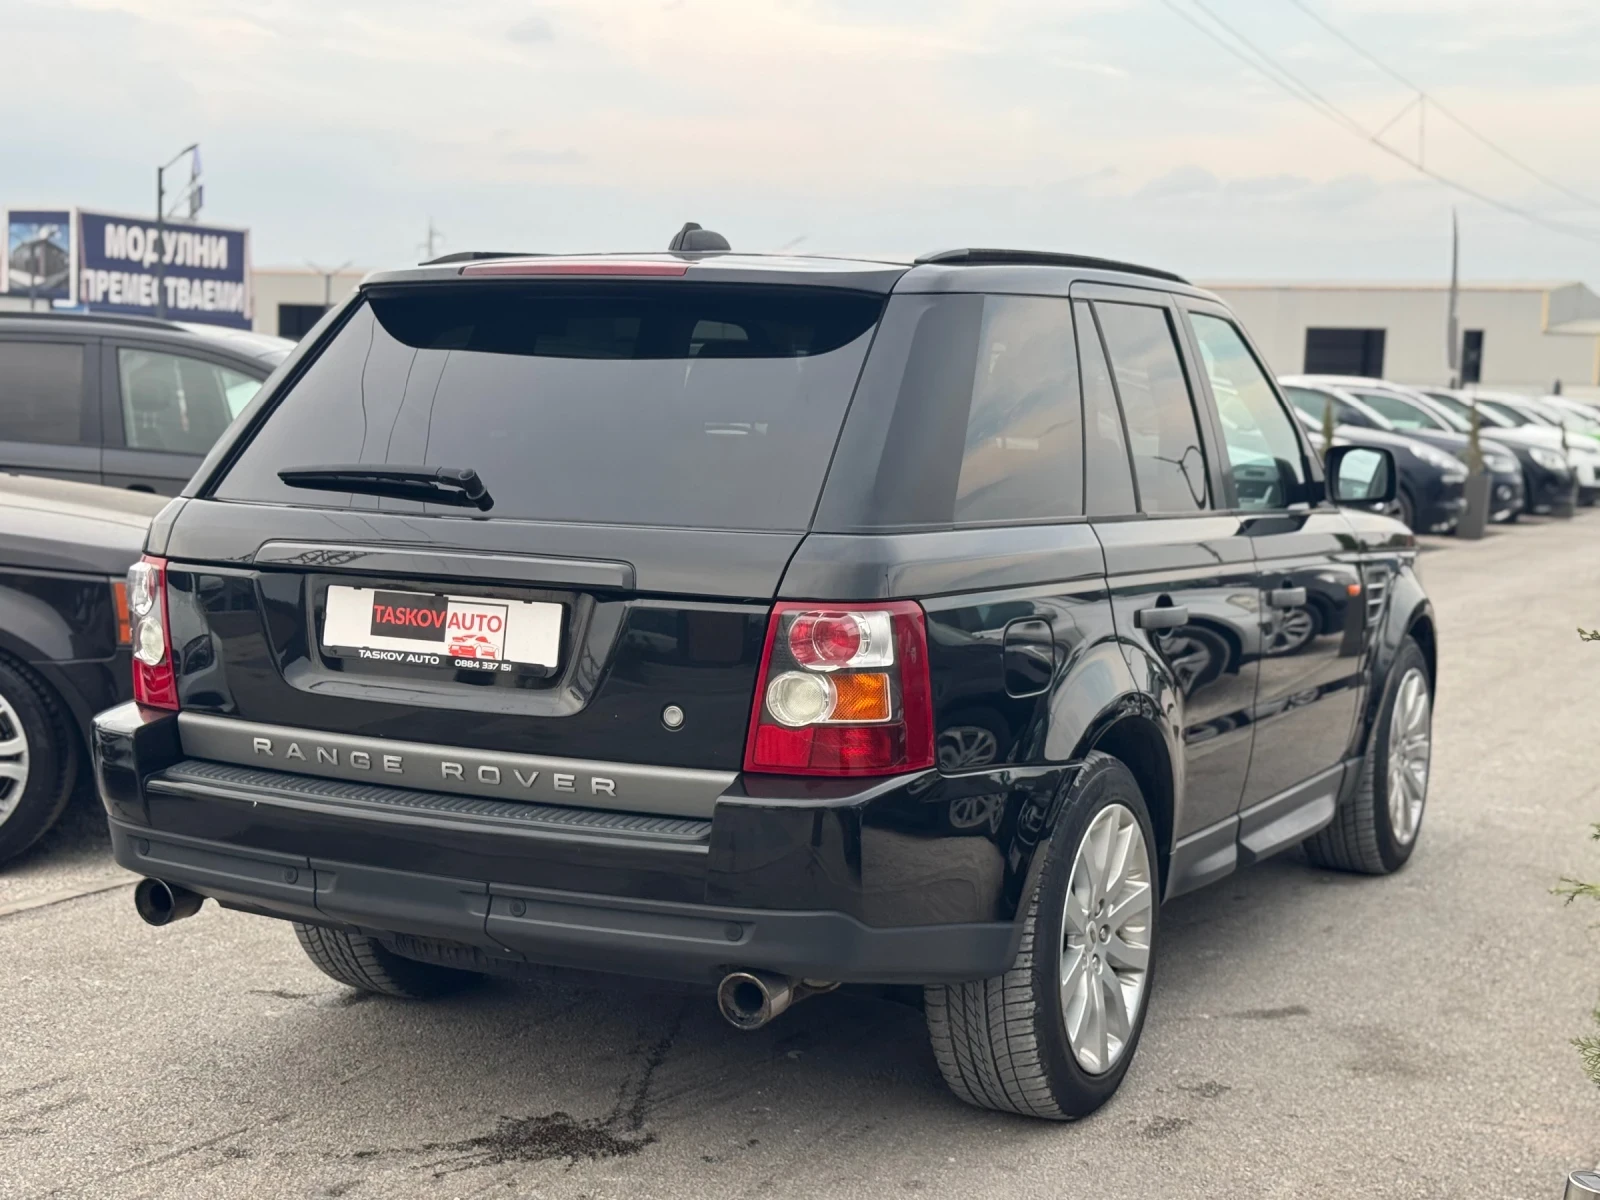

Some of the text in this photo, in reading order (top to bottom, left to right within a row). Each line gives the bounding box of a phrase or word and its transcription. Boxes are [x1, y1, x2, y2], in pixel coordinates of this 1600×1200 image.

[104, 223, 228, 269] МОДУЛНИ
[373, 604, 503, 633] TASKOV AUTO
[358, 649, 440, 665] TASKOV AUTO
[454, 659, 480, 669] 0884
[481, 661, 499, 671] 337
[252, 736, 617, 797] RANGE ROVER
